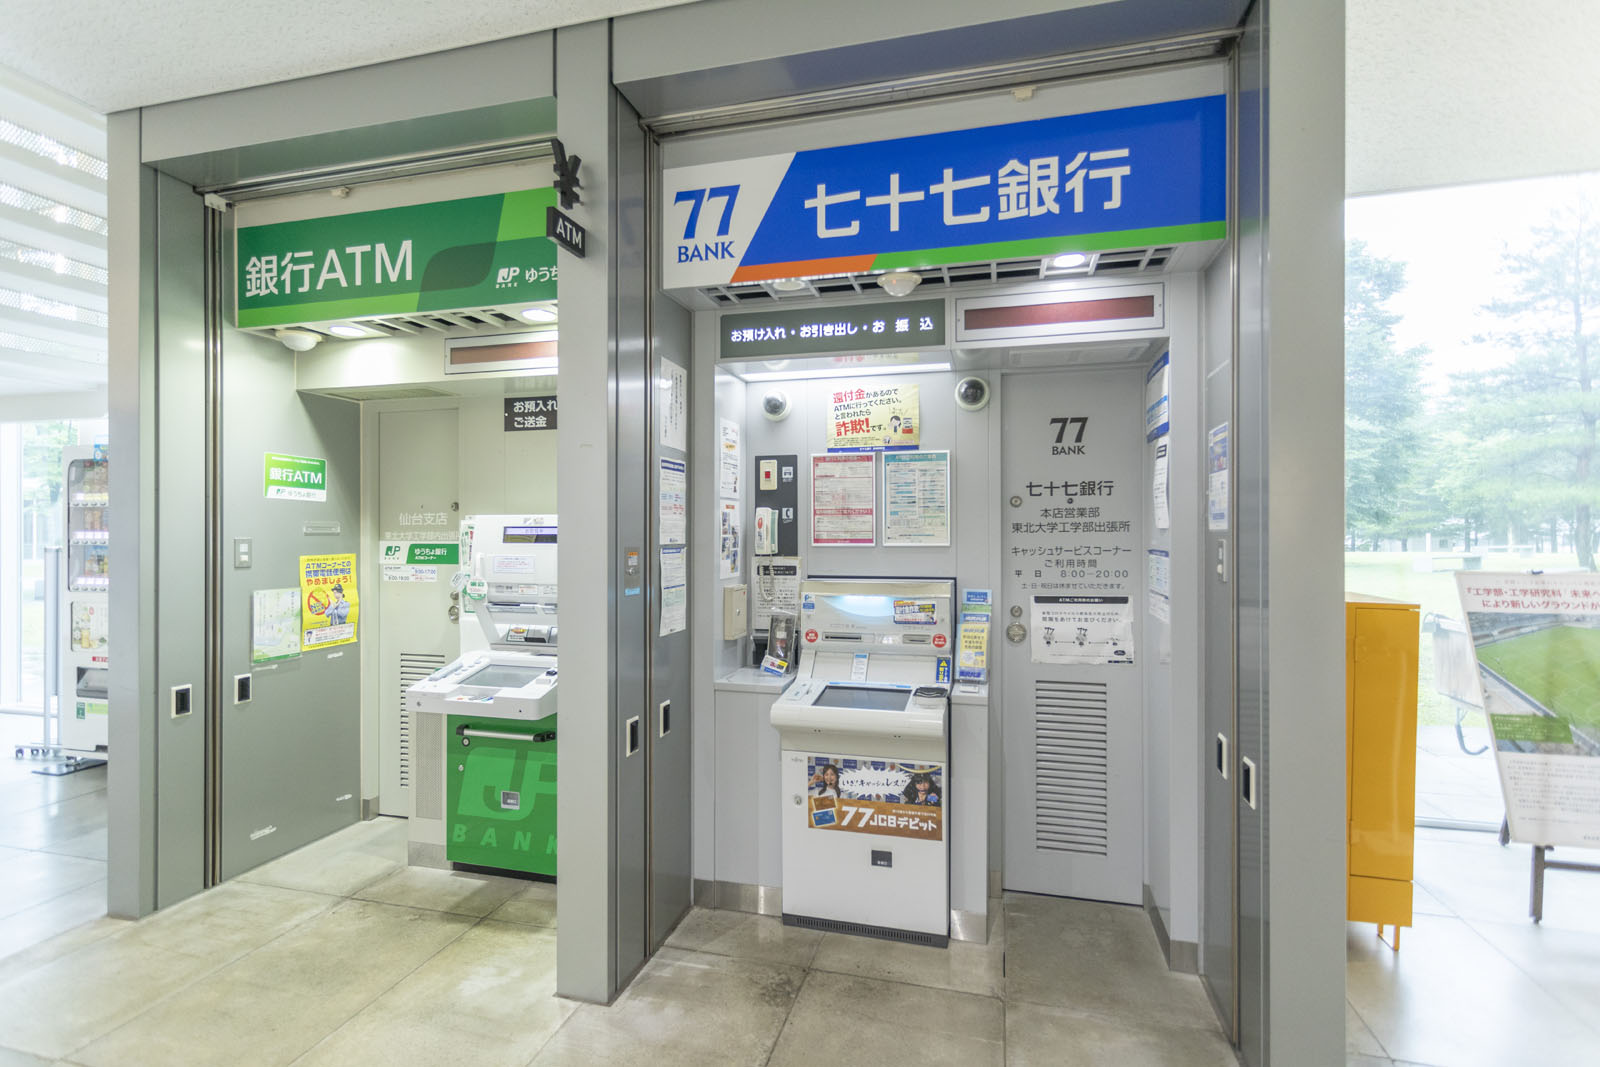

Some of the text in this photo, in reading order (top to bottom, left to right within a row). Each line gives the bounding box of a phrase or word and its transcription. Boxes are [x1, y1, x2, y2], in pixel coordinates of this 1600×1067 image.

[804, 148, 1131, 239] 七十七銀行
[673, 184, 741, 240] 77
[556, 217, 582, 249] ATM
[677, 240, 736, 263] BANK
[245, 240, 413, 297] 銀行ATM
[513, 400, 558, 413] お預入れ
[513, 415, 547, 428] ご送金
[1049, 417, 1089, 443] 77
[1052, 445, 1086, 456] BANK
[269, 467, 322, 484] 銀行ATM
[1026, 480, 1114, 497] 七十七銀行
[399, 512, 448, 526] 仙台支店
[1040, 507, 1100, 519] 本店営業部
[1011, 520, 1131, 534] 東北大学工学部出張所
[414, 548, 447, 556] ゆうちょ銀行
[1011, 546, 1132, 557] キャッシュサービスコーナー
[1044, 559, 1097, 568] ご利用時間
